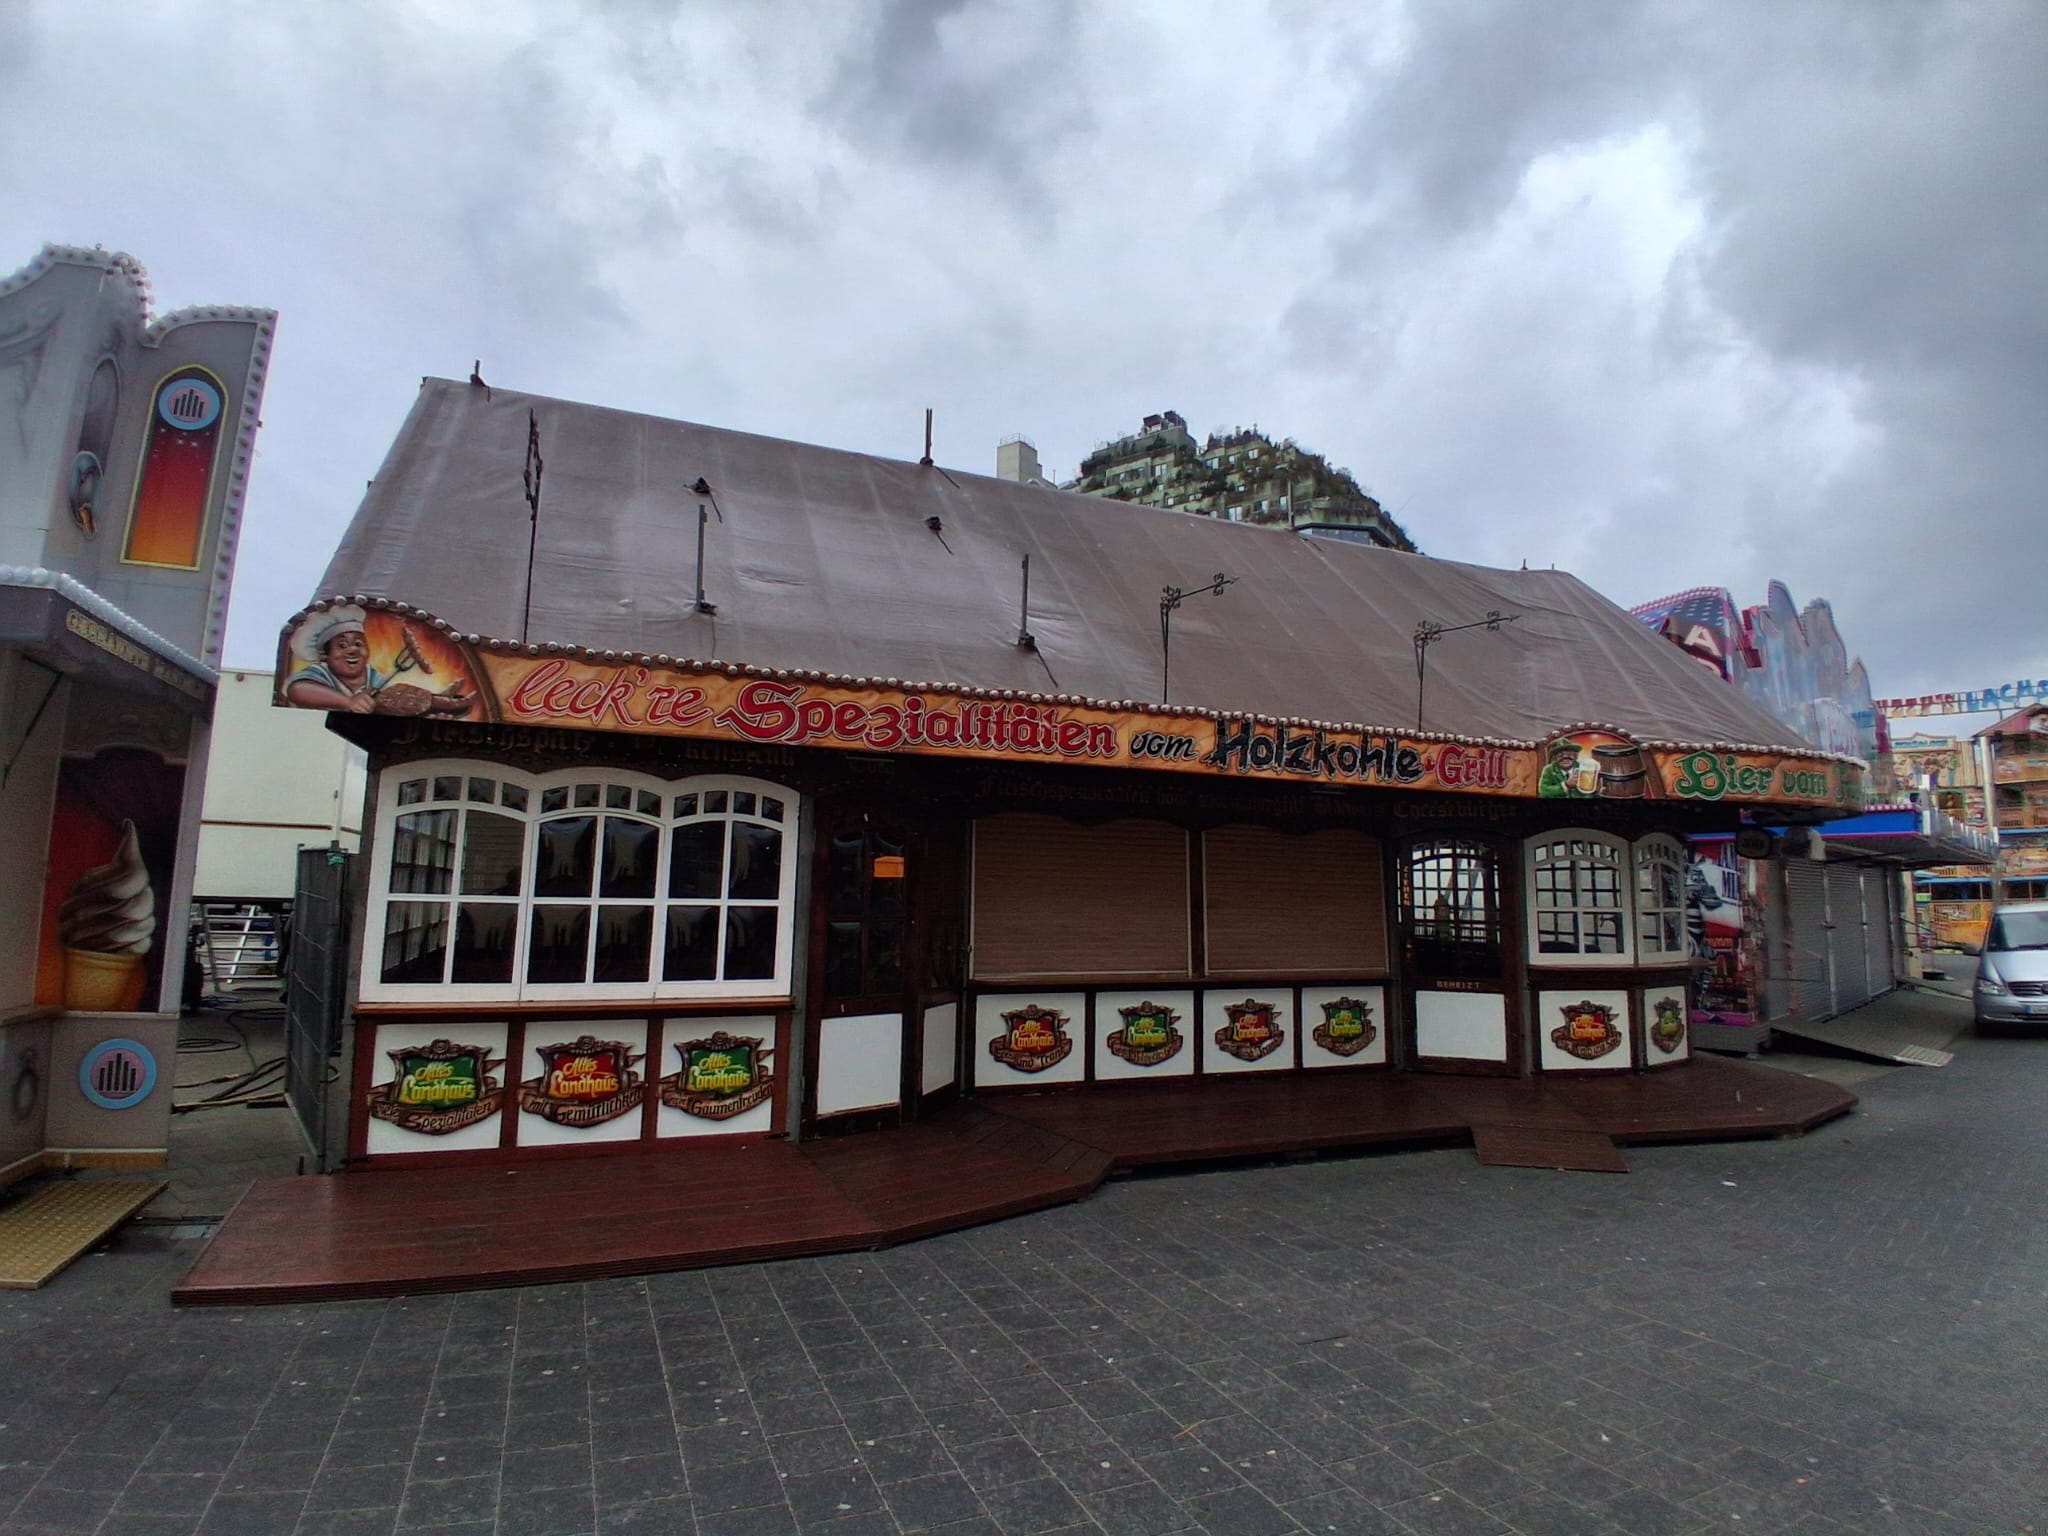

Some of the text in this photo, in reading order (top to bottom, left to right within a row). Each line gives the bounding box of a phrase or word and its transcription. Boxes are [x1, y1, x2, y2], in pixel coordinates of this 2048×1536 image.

[508, 658, 713, 727] leck're
[715, 679, 1117, 757] Spezialitäten
[1127, 730, 1200, 762] vom
[1673, 750, 1774, 801] Bier
[1782, 768, 1829, 798] vom
